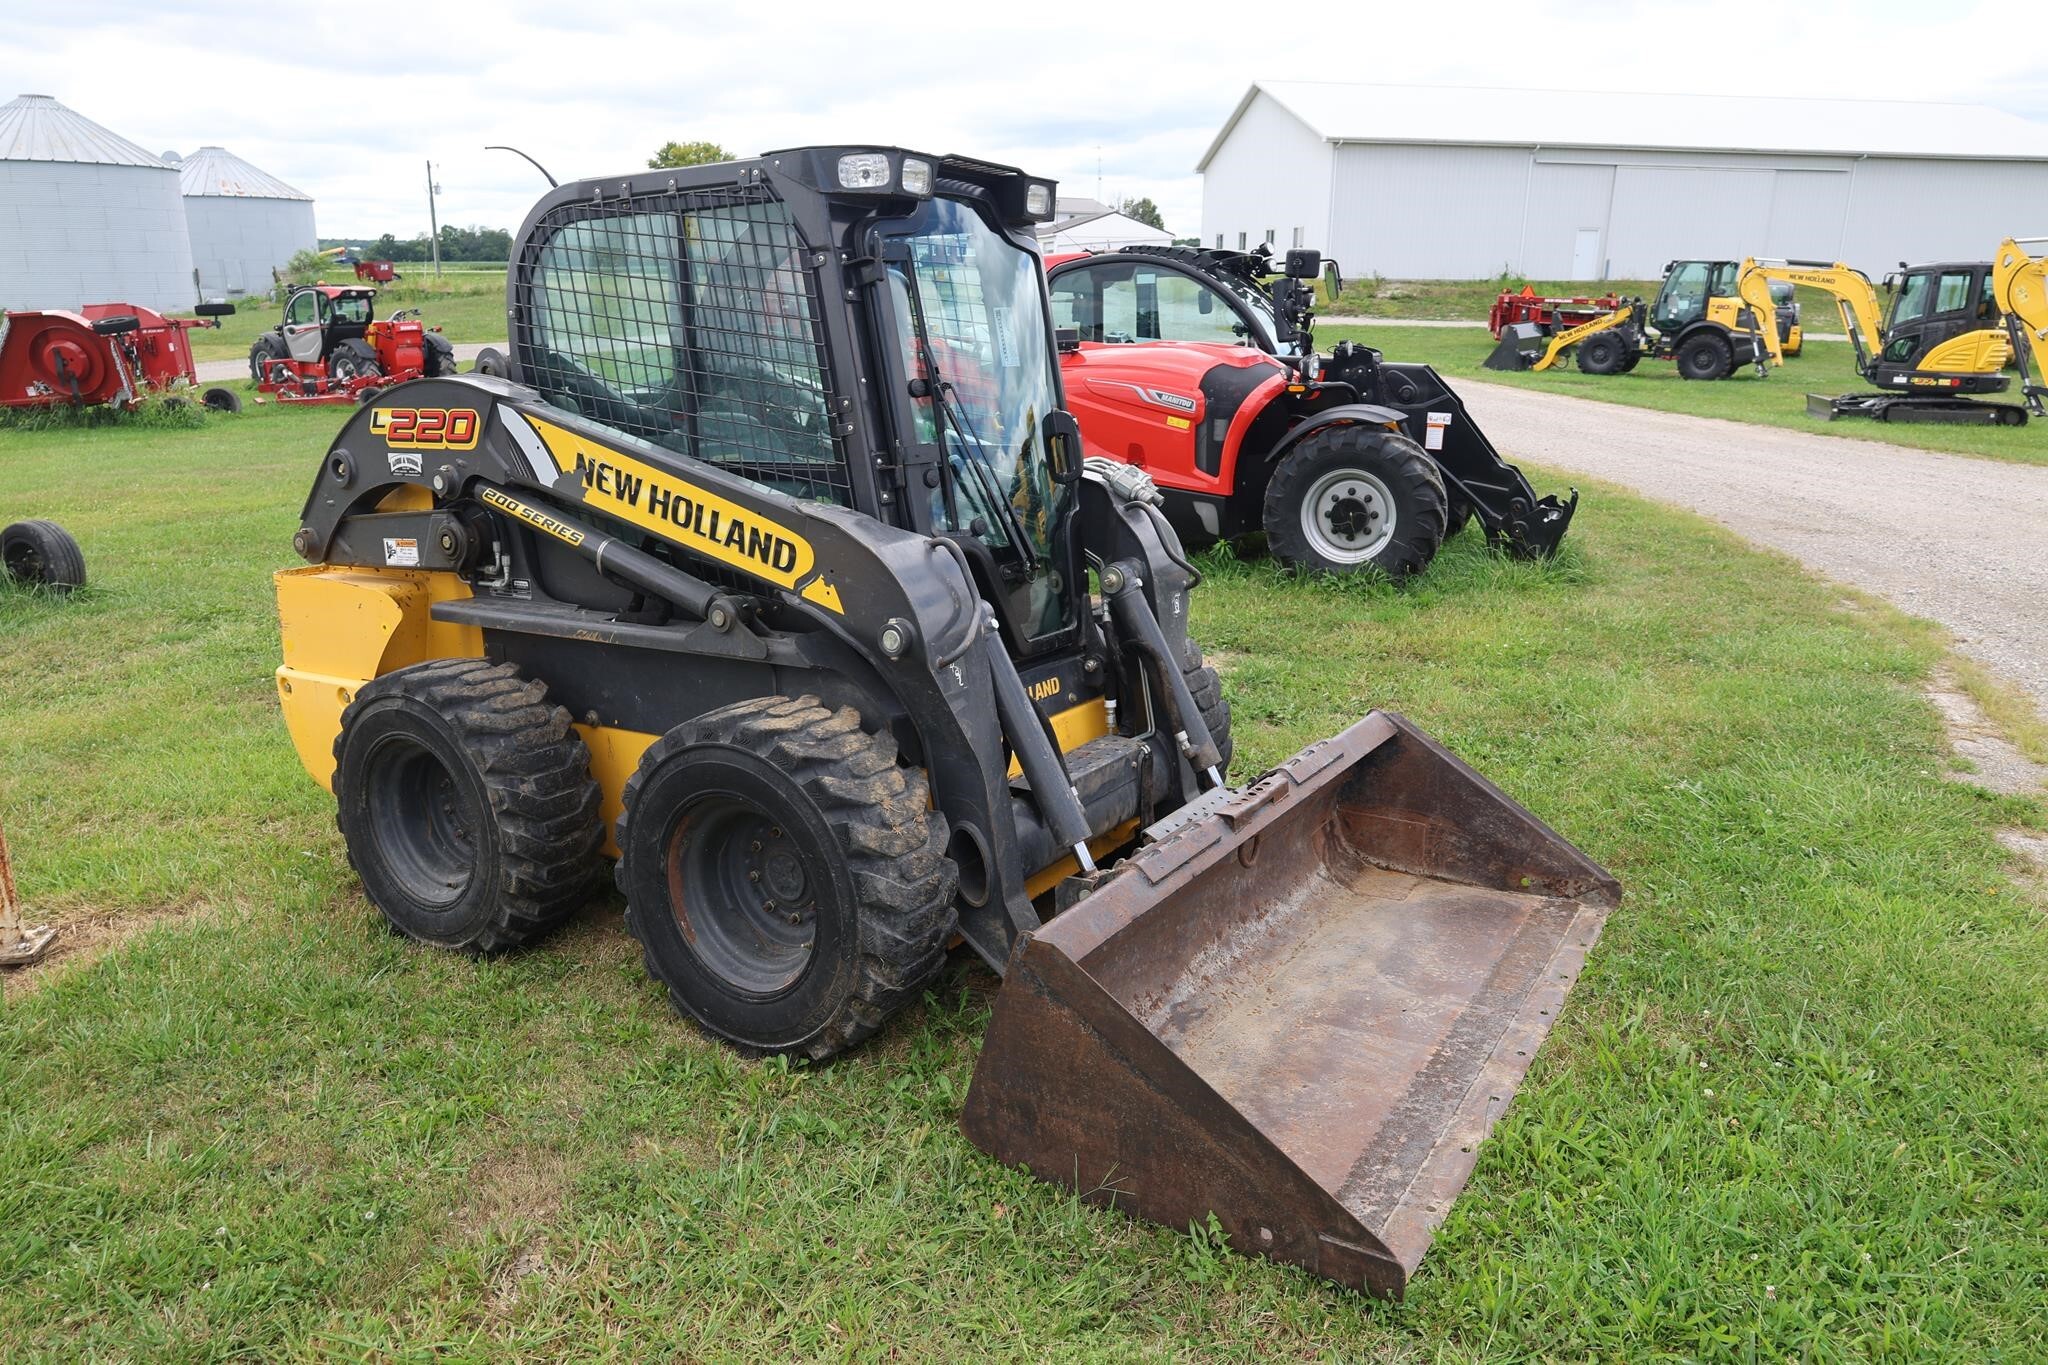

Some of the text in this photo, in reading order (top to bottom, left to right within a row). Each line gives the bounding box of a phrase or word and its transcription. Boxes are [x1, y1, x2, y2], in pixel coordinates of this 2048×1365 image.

[1788, 273, 1836, 285] NEW HOLLAND
[1559, 319, 1603, 340] NEW HOLLAND
[1161, 394, 1192, 408] MANITOU
[484, 489, 583, 543] 200 SERIES
[576, 452, 798, 575] NEW HOLLAND
[1025, 676, 1061, 701] LAND
